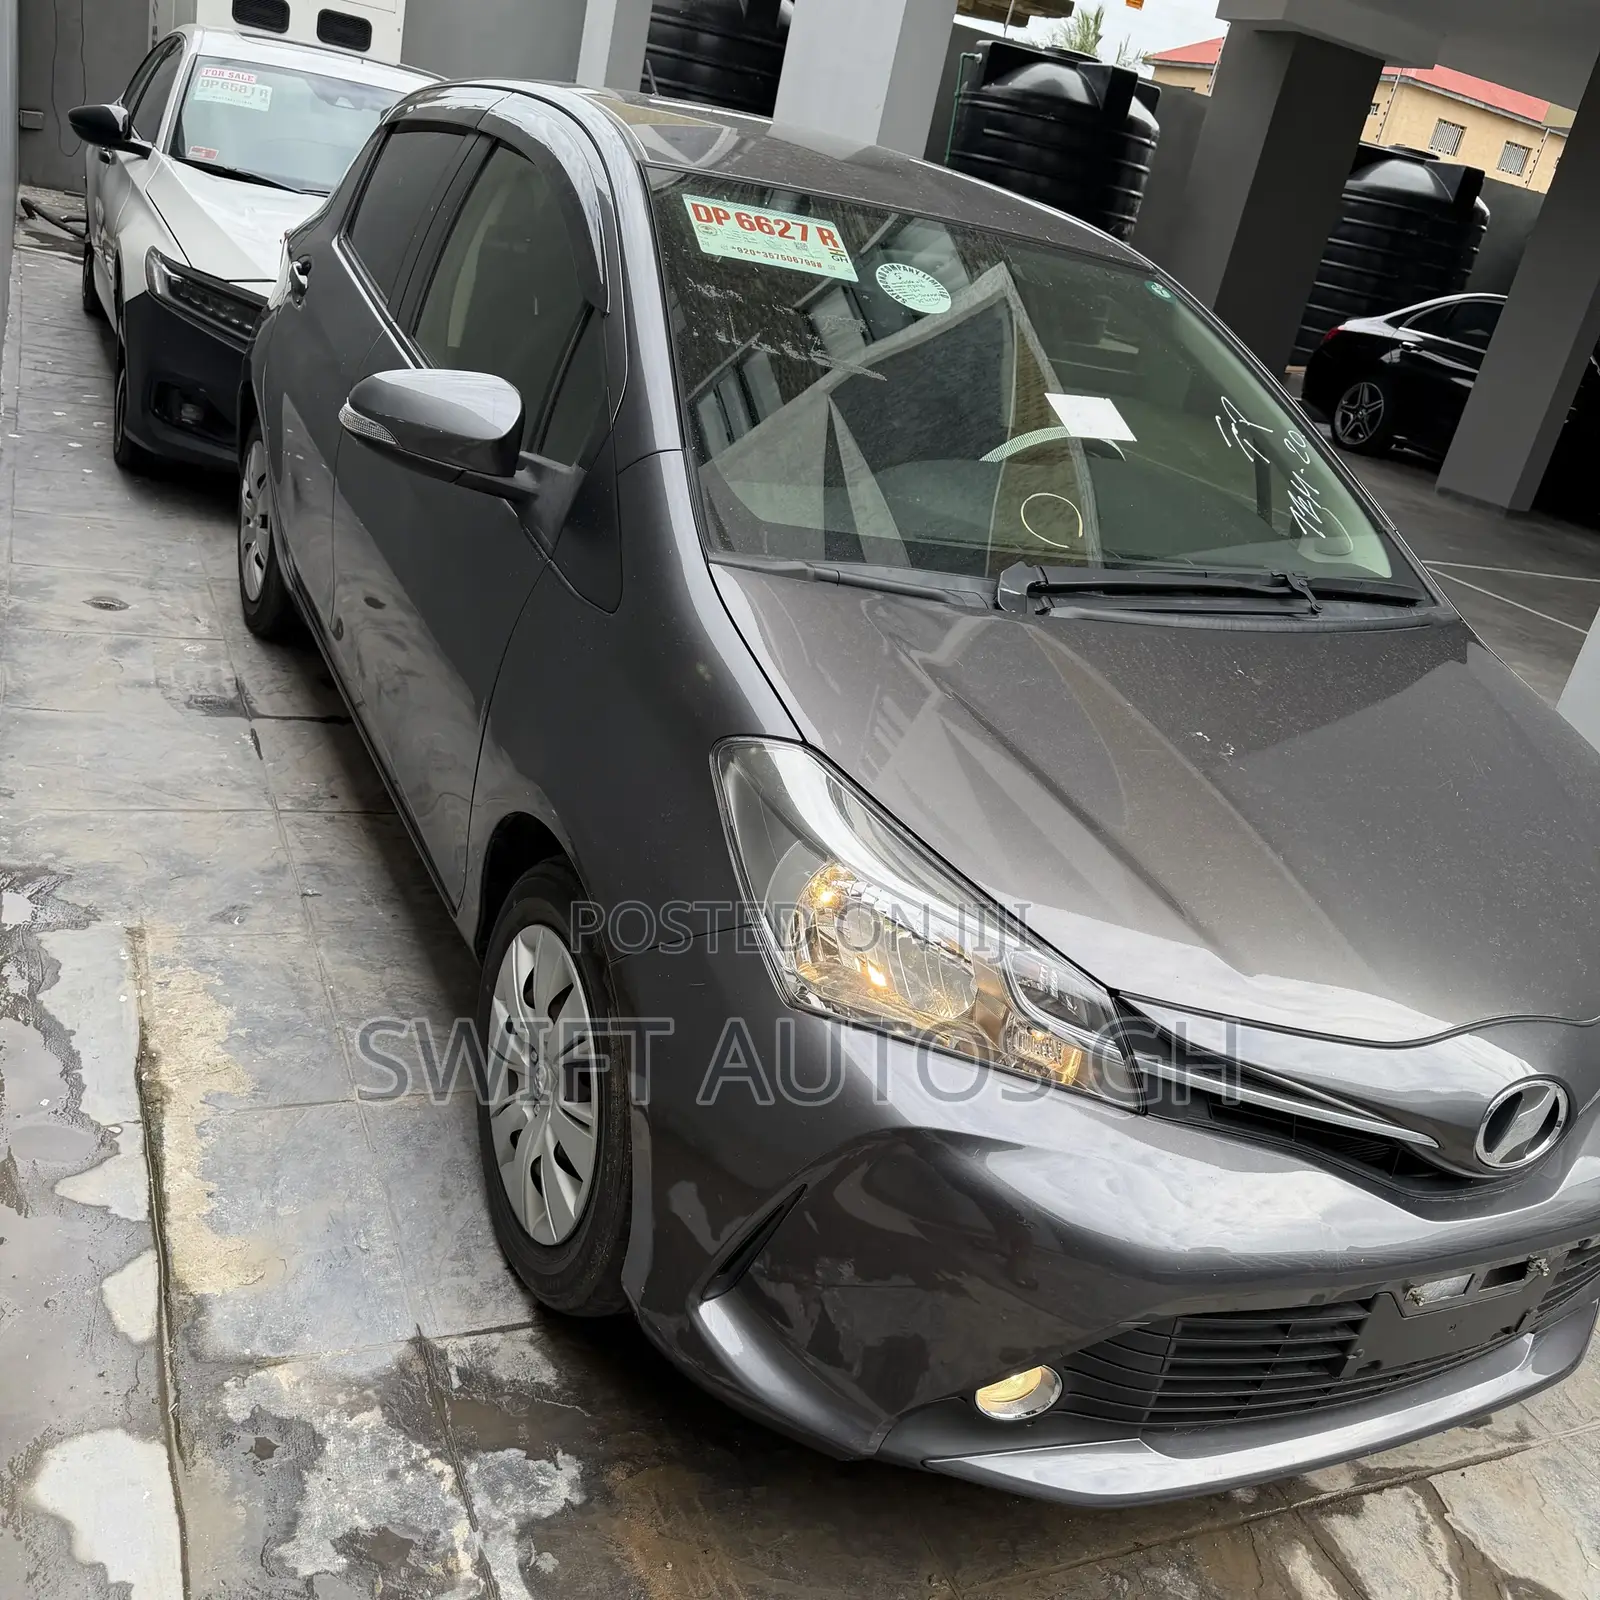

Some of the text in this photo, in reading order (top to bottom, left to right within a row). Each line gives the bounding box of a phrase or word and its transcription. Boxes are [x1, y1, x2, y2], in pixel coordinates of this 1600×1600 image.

[204, 69, 254, 82] FOR SALE
[691, 203, 731, 226] DP
[734, 211, 809, 242] 6627
[816, 226, 840, 249] R
[832, 255, 849, 264] GH
